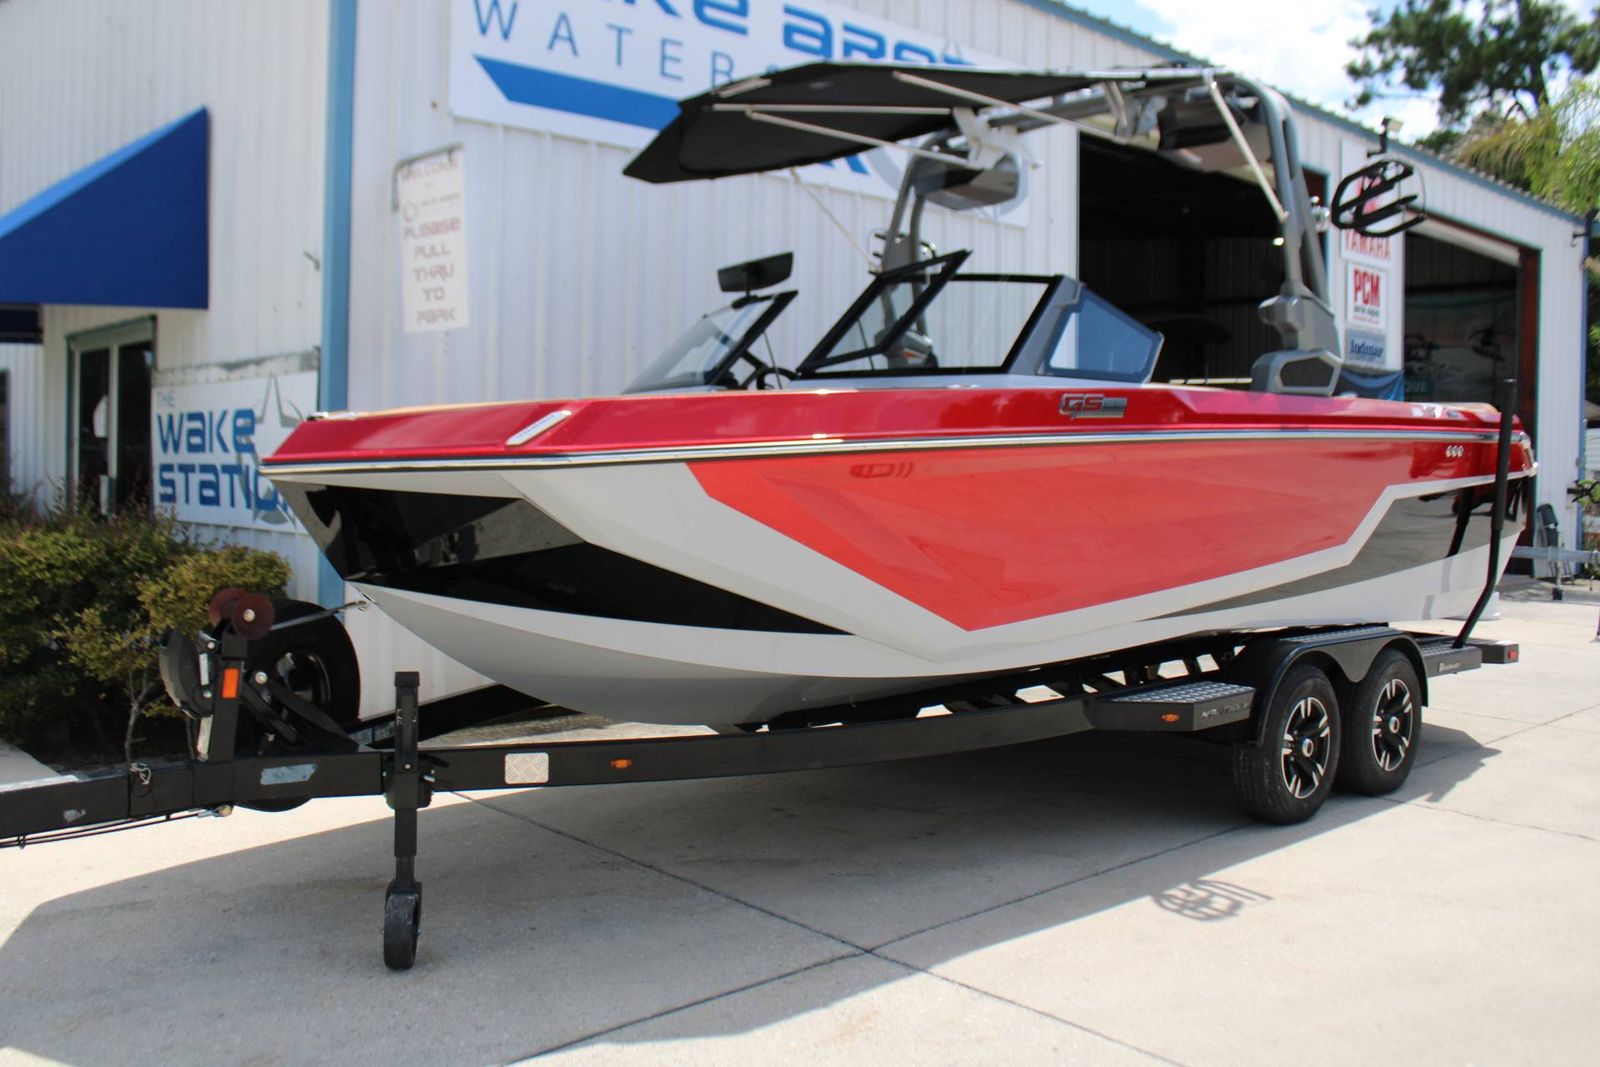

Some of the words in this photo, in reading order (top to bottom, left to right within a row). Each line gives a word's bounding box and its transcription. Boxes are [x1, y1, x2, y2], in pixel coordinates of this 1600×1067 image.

[413, 263, 455, 282] THRU
[422, 287, 445, 302] TO
[1353, 269, 1381, 306] PCM
